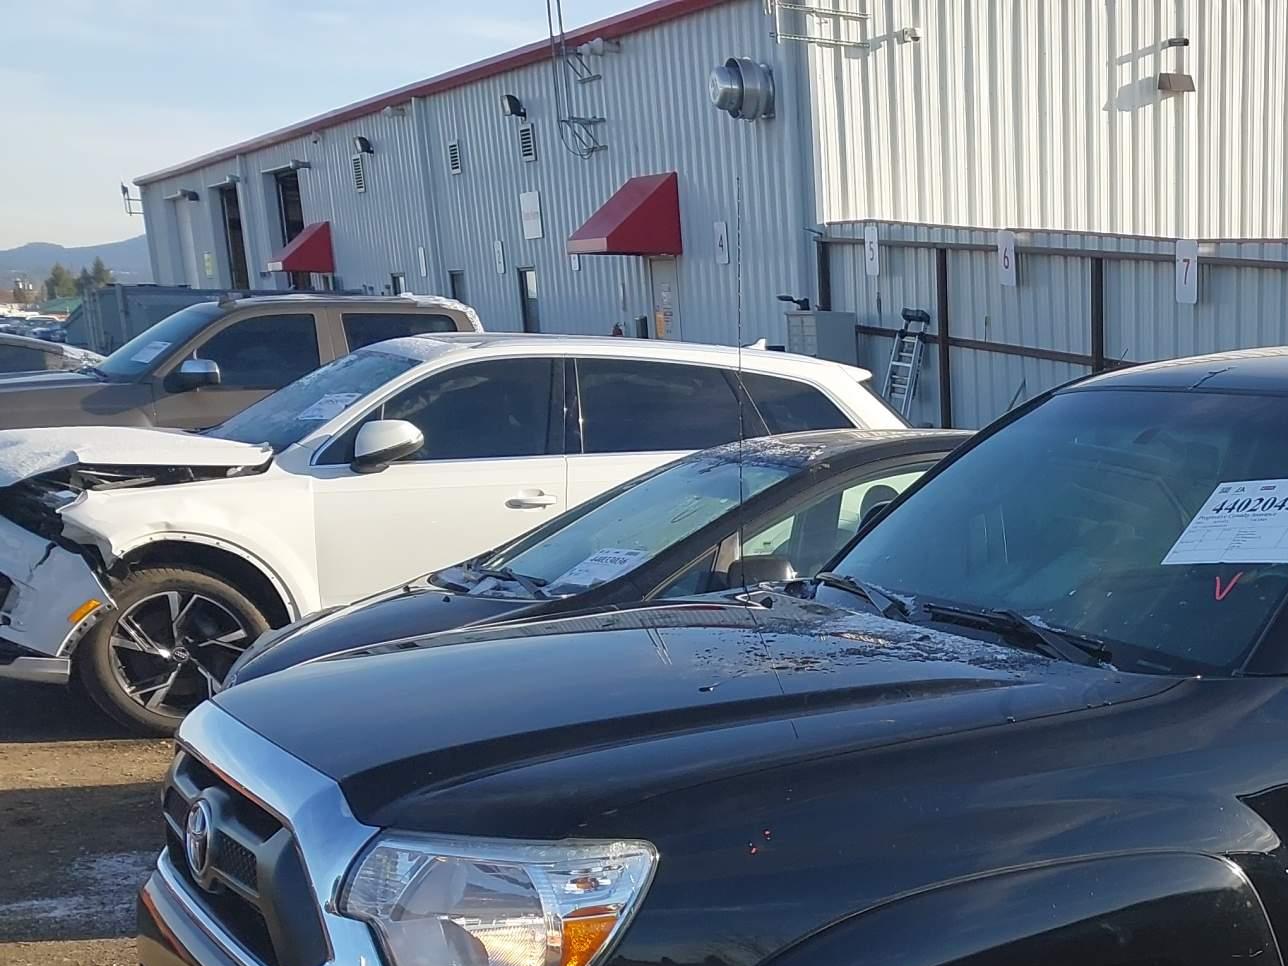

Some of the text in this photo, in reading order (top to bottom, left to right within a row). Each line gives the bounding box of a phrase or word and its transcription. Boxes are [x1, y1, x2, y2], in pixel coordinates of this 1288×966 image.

[869, 240, 875, 261] 5
[1003, 247, 1010, 270] 6
[1182, 258, 1191, 286] 7
